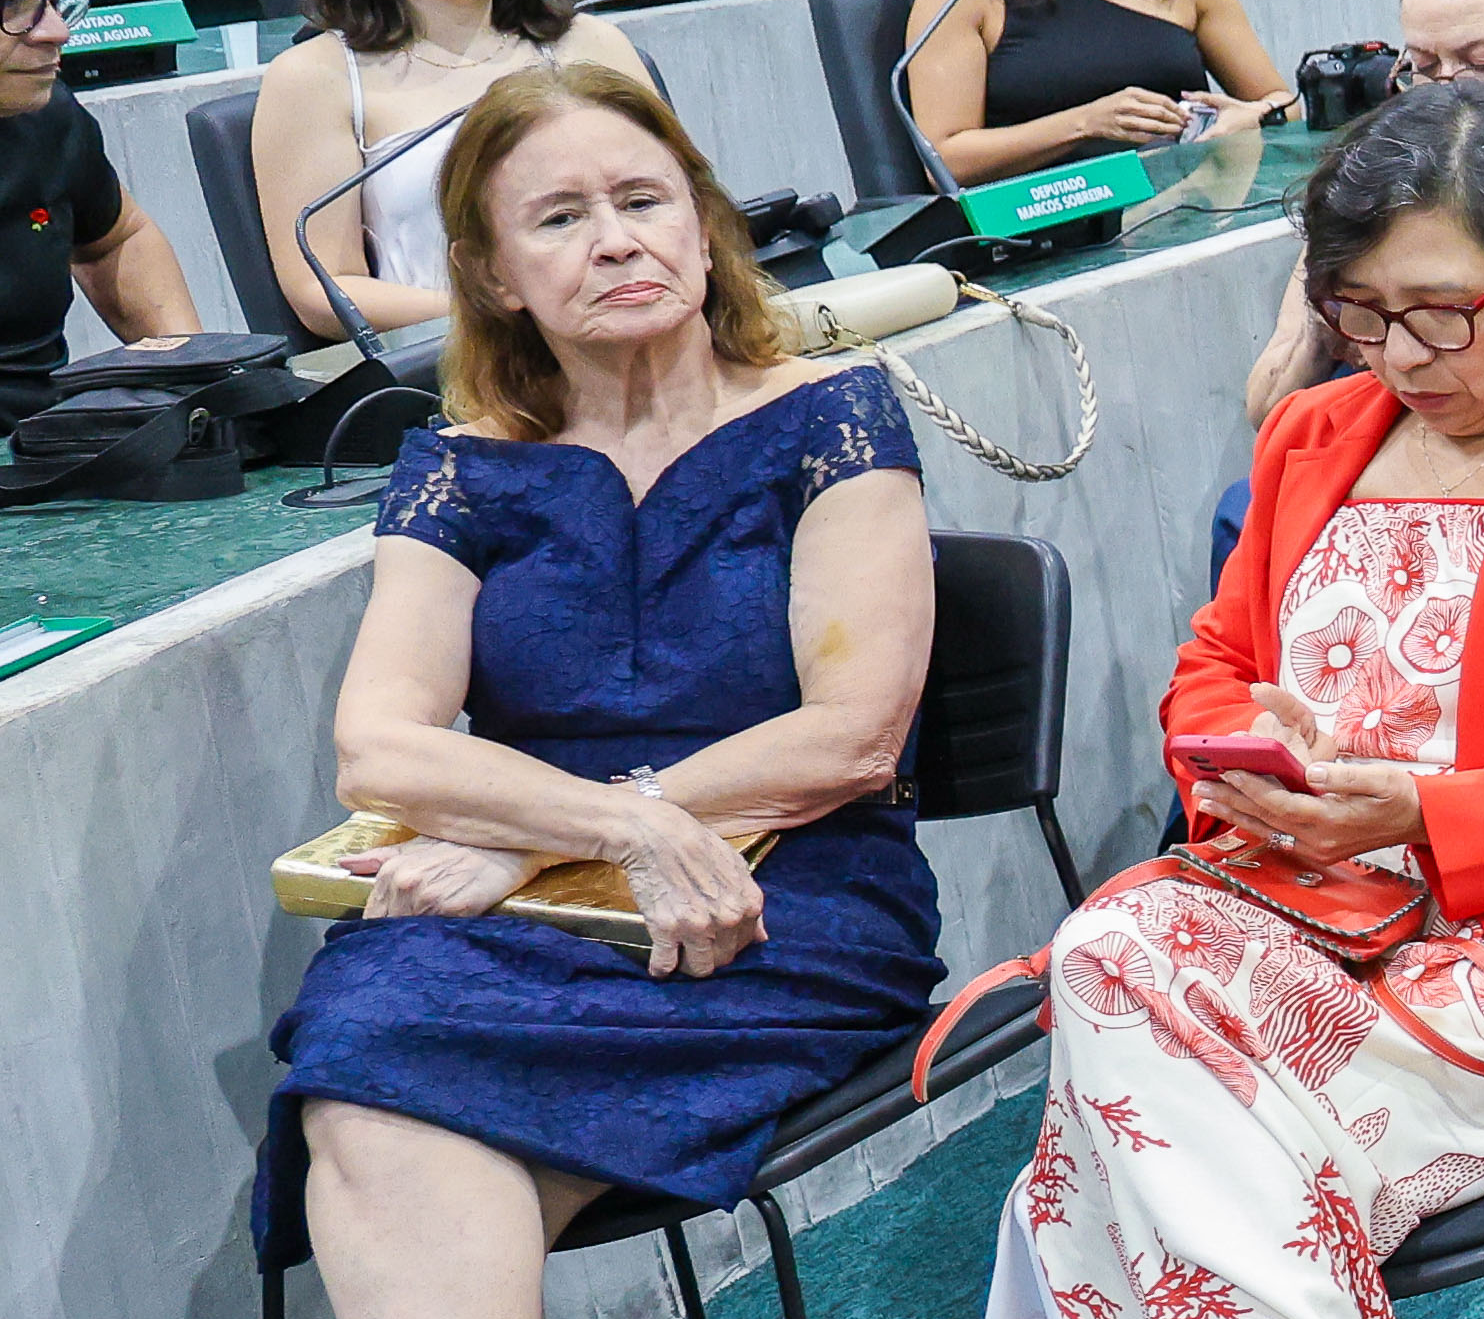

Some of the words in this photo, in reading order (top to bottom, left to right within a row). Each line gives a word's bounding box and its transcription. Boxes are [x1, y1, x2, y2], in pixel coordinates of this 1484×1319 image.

[103, 26, 153, 42] AGUIAR
[1029, 175, 1088, 202] DEPUTADO
[1016, 197, 1064, 222] MARCOS
[1062, 185, 1115, 210] SOBREIRA
